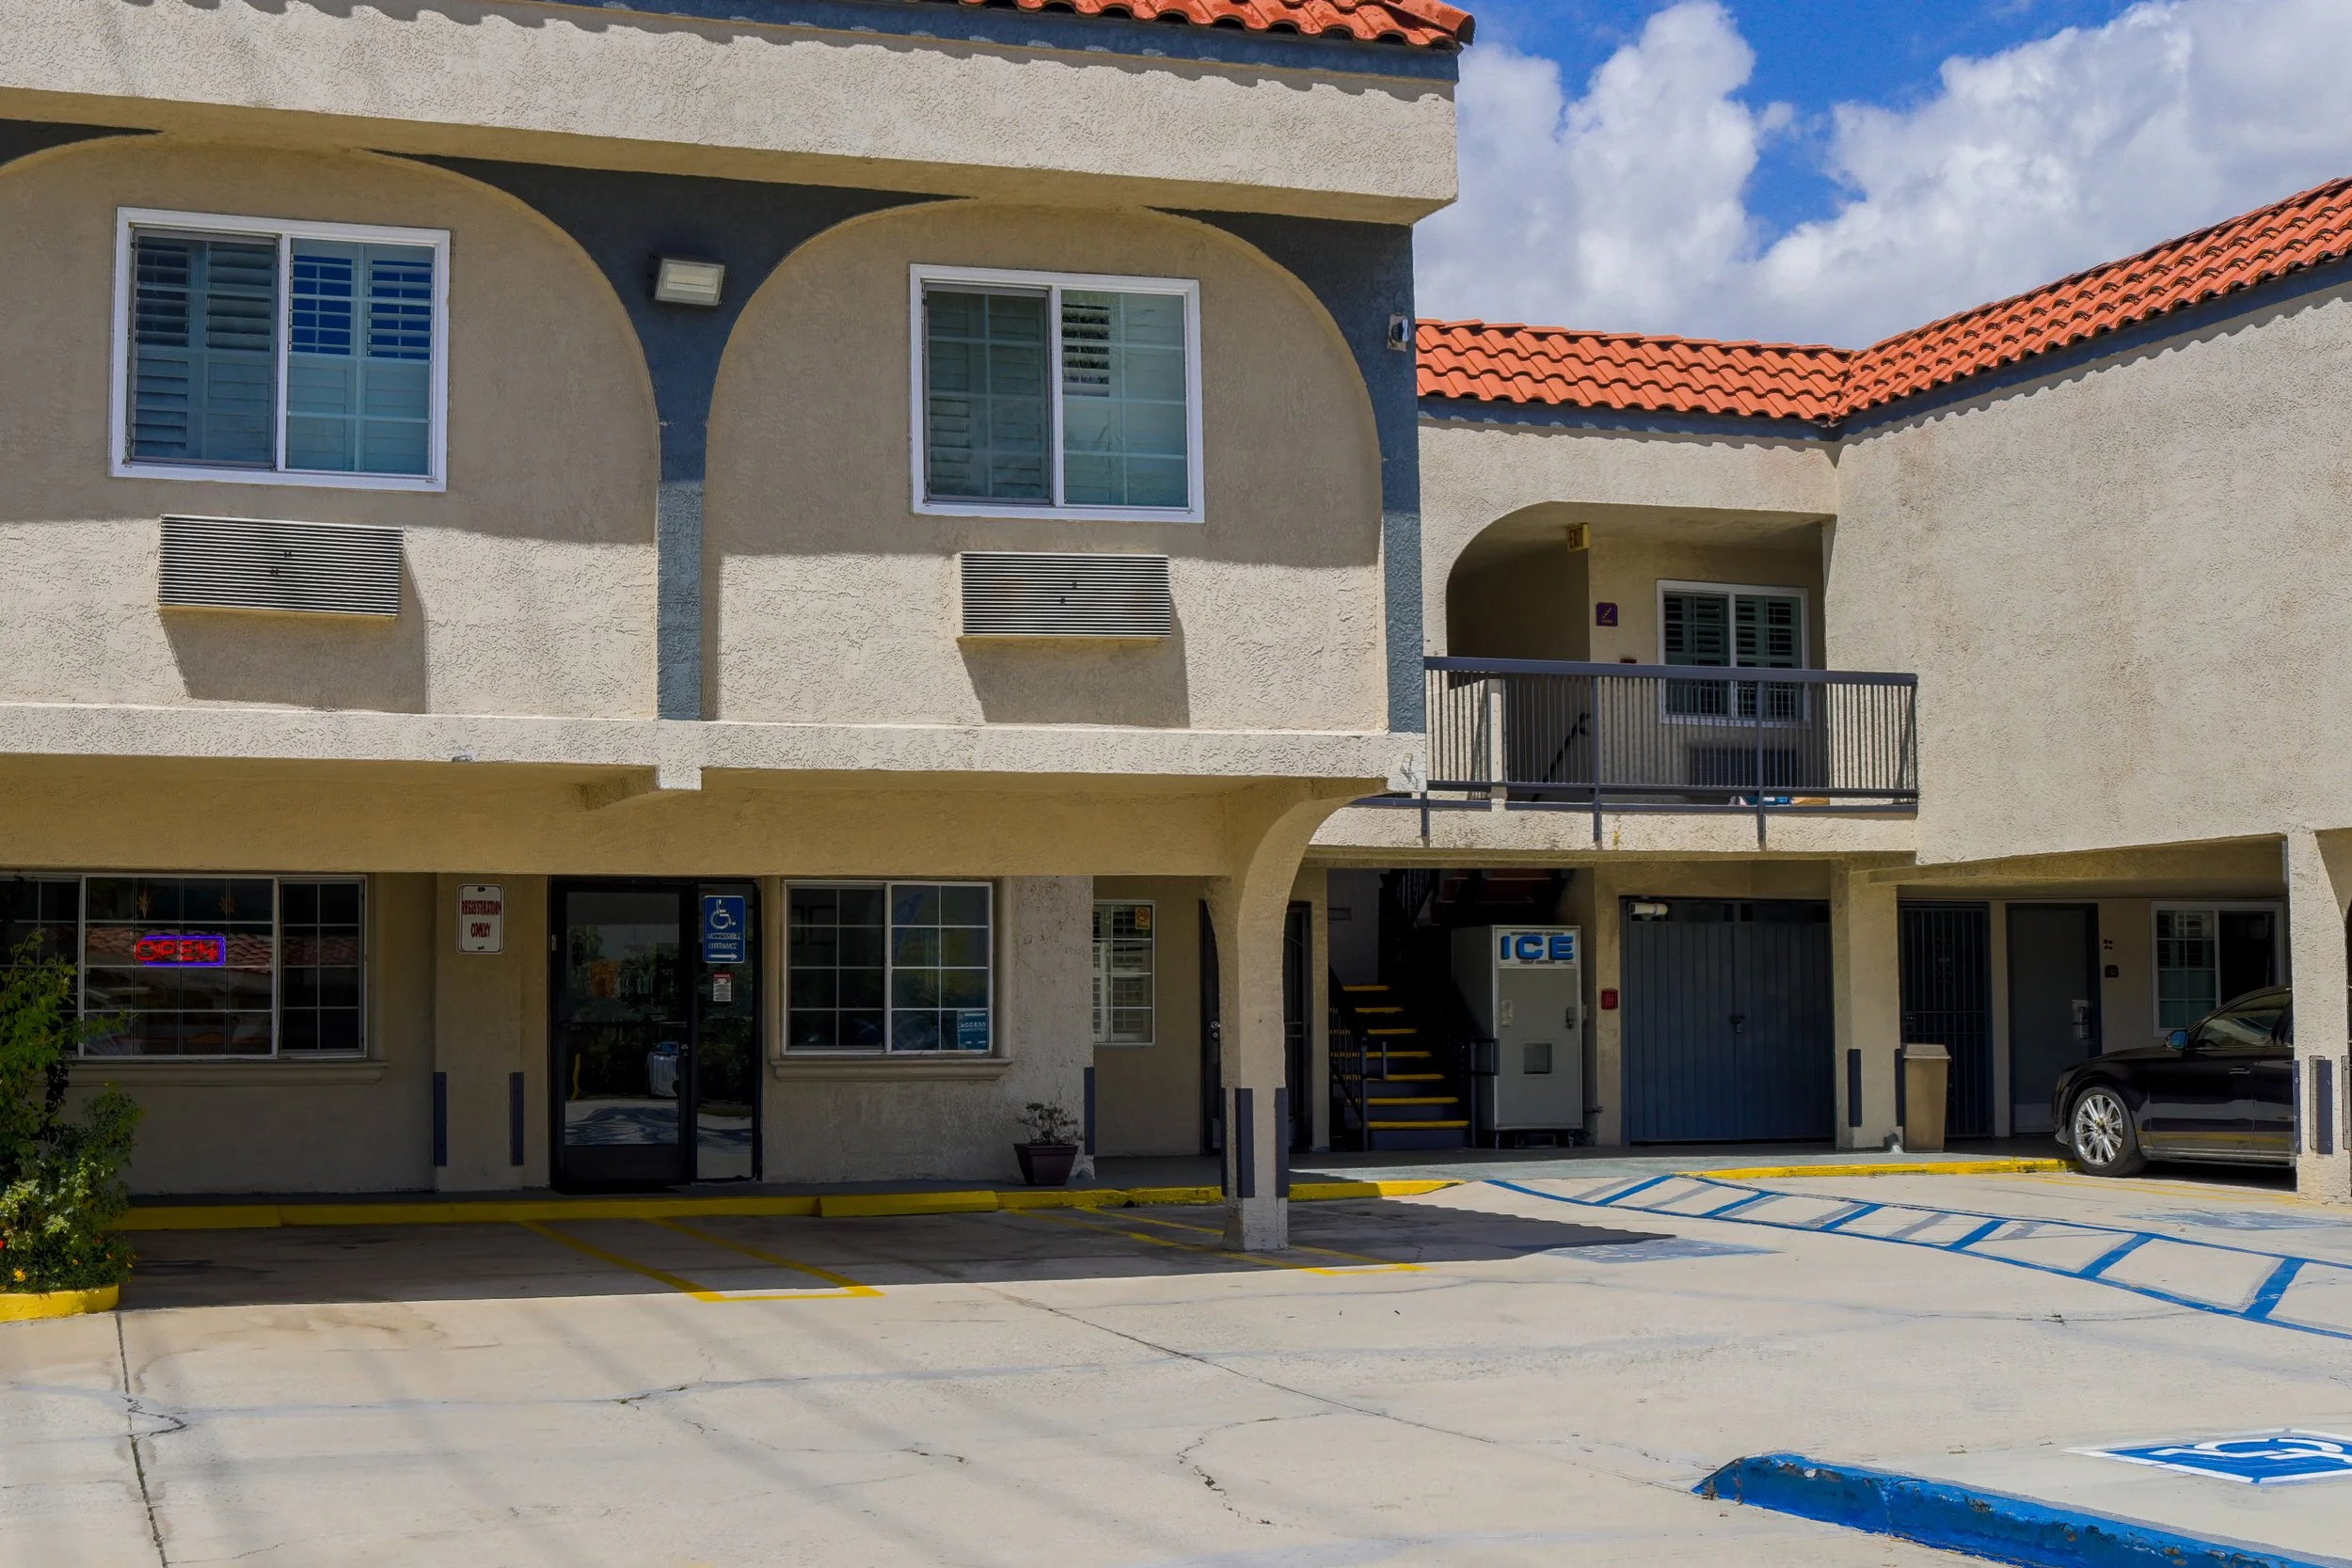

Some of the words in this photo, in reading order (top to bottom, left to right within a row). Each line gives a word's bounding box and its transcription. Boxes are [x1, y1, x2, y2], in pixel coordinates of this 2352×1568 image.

[462, 900, 501, 915] REGISTRATION
[470, 923, 491, 938] ONLY
[135, 941, 218, 960] OPEN
[1501, 936, 1573, 959] ICE
